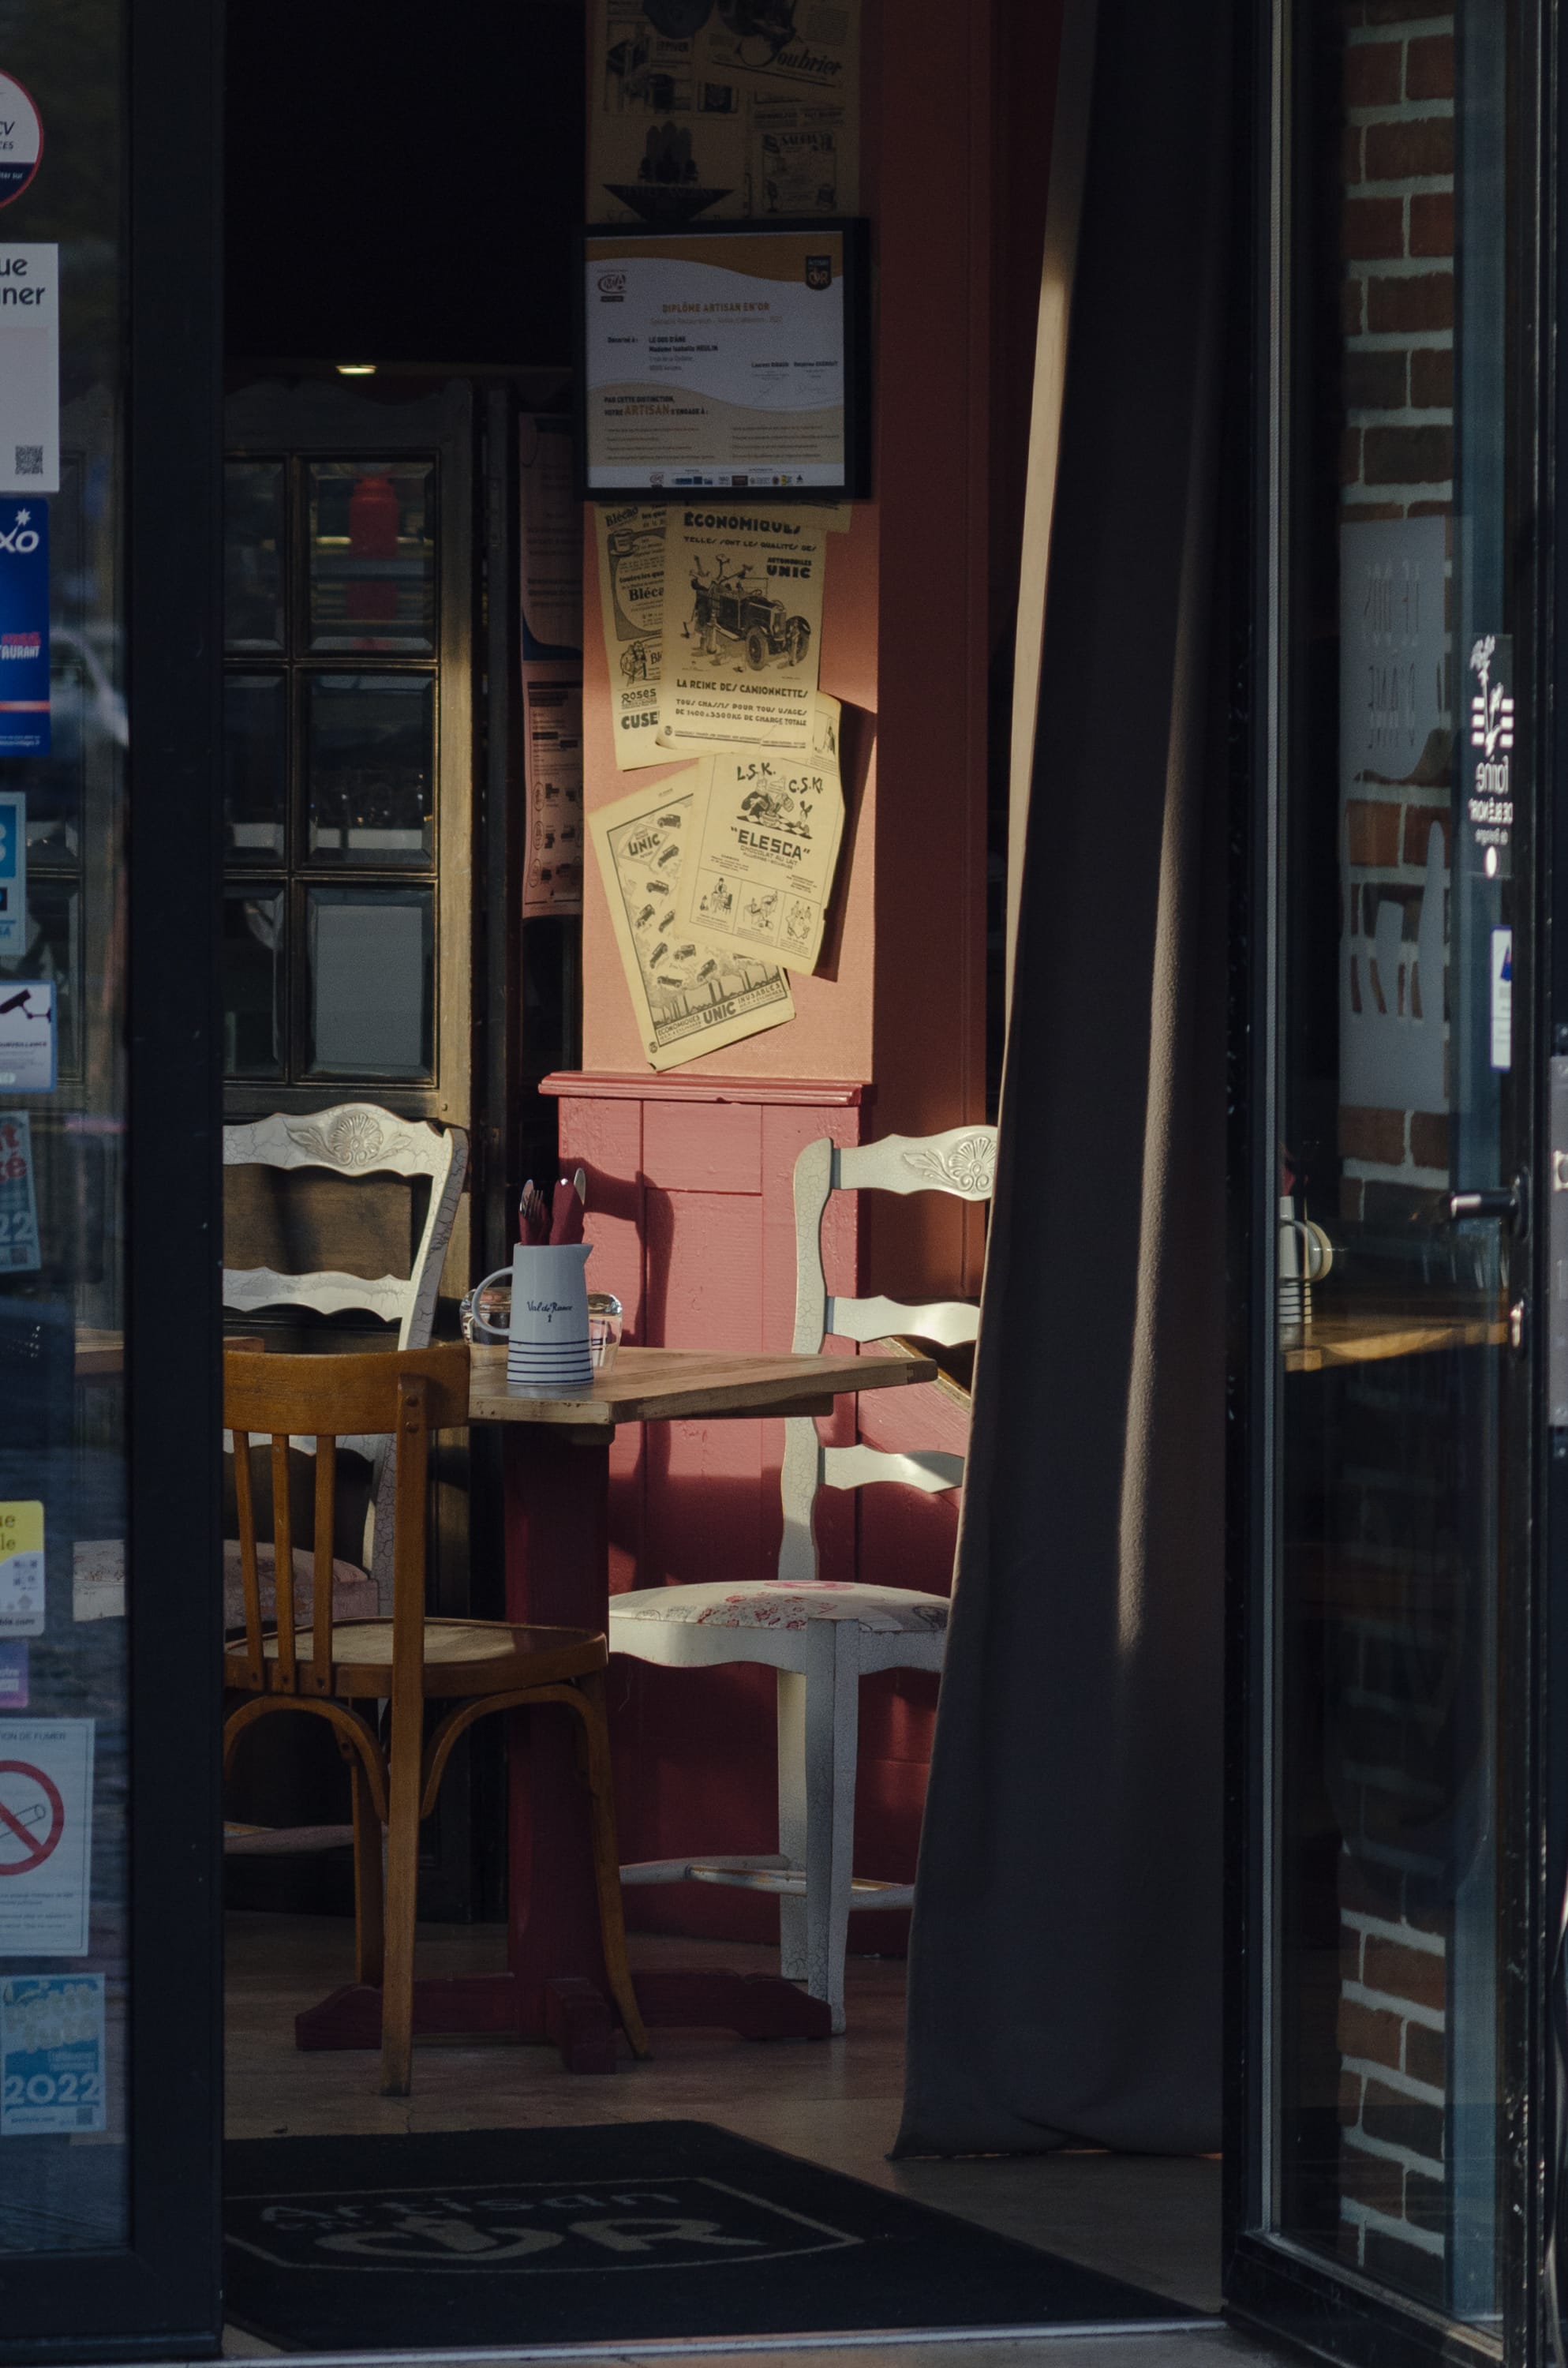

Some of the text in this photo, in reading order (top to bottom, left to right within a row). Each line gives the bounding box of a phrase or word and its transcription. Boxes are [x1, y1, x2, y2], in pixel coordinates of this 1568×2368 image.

[704, 303, 741, 313] ARTISAN
[625, 404, 669, 416] ARTISAN
[720, 538, 740, 547] SONT
[766, 565, 811, 579] UNIC
[621, 688, 657, 703] Roses
[676, 679, 809, 699] LA REINE DES CAMIONNETTES
[732, 703, 754, 711] POUR
[778, 707, 807, 716] USAGES
[755, 715, 784, 725] CHARGE
[628, 833, 661, 856] UNIC
[740, 845, 774, 858] CHOCOLAT
[702, 1001, 736, 1025] UNIC
[738, 982, 780, 1004] INUSABLES
[527, 1300, 542, 1312] Val
[5, 2072, 99, 2105] 2022
